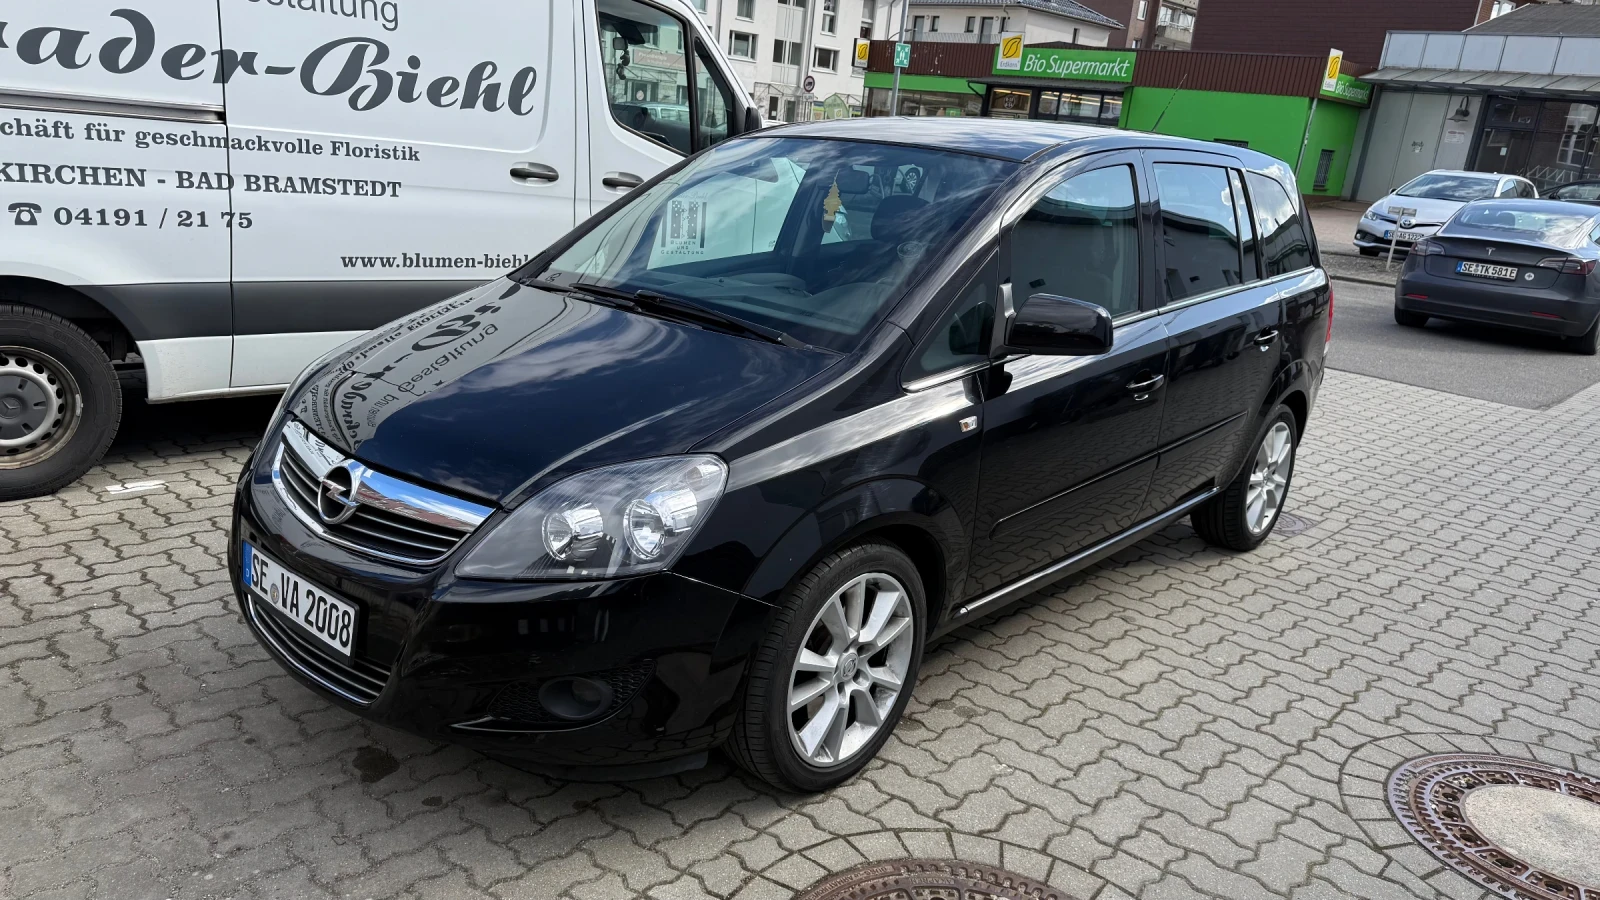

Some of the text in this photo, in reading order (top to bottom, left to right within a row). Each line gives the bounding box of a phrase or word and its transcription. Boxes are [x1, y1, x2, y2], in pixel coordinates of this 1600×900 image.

[0, 8, 538, 116] ader-Biehl
[1024, 54, 1131, 77] Bio Supermarkt
[0, 117, 421, 162] chäft für geschmackvolle Floristik
[175, 170, 235, 191] BAD
[243, 174, 402, 198] BRAMSTEDT
[53, 206, 253, 229] 04191 / 21 75
[1462, 262, 1474, 273] SE
[1480, 264, 1491, 275] TK
[251, 553, 269, 596] SE
[281, 572, 299, 618] VA
[304, 588, 352, 649] 2008
